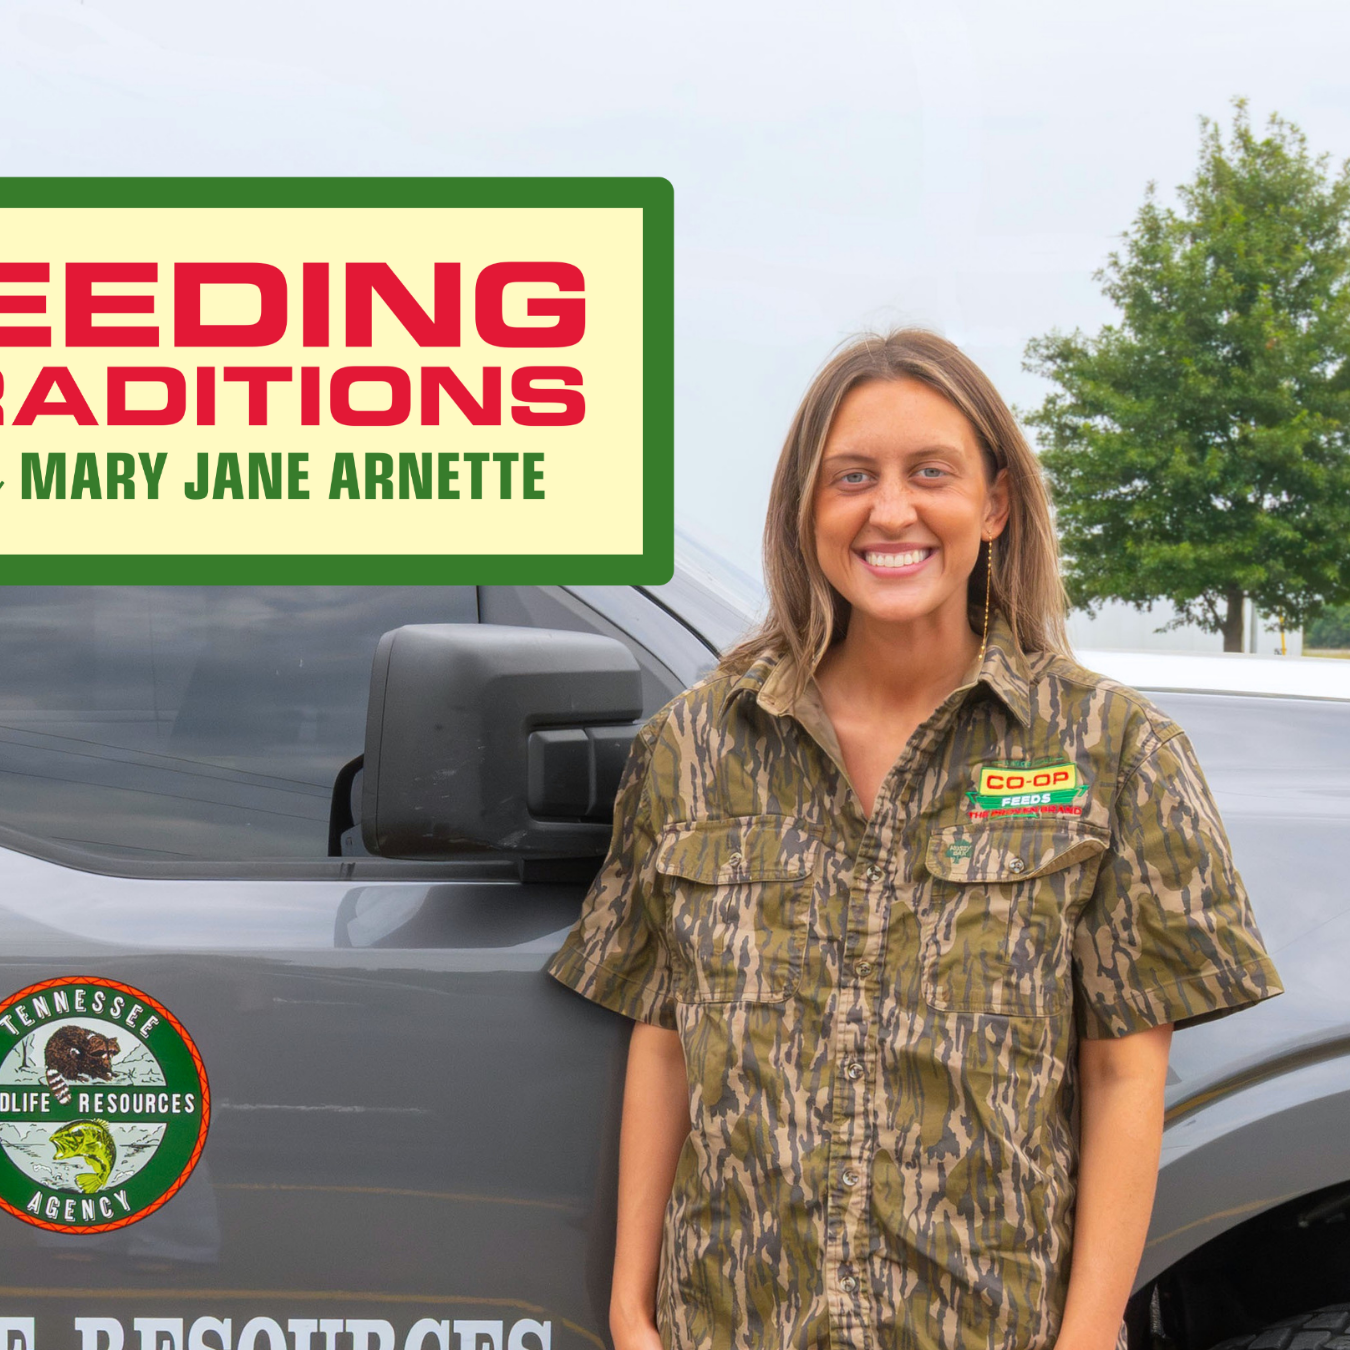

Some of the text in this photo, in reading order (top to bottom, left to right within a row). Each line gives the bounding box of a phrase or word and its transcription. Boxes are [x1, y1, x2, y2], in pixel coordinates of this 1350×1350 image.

[986, 771, 1069, 790] CO-OP
[1001, 793, 1051, 807] FEEDS
[968, 804, 1082, 819] THE PROVEN BRAND
[79, 1092, 195, 1114] RESOURCES
[26, 1189, 132, 1222] AGENCY
